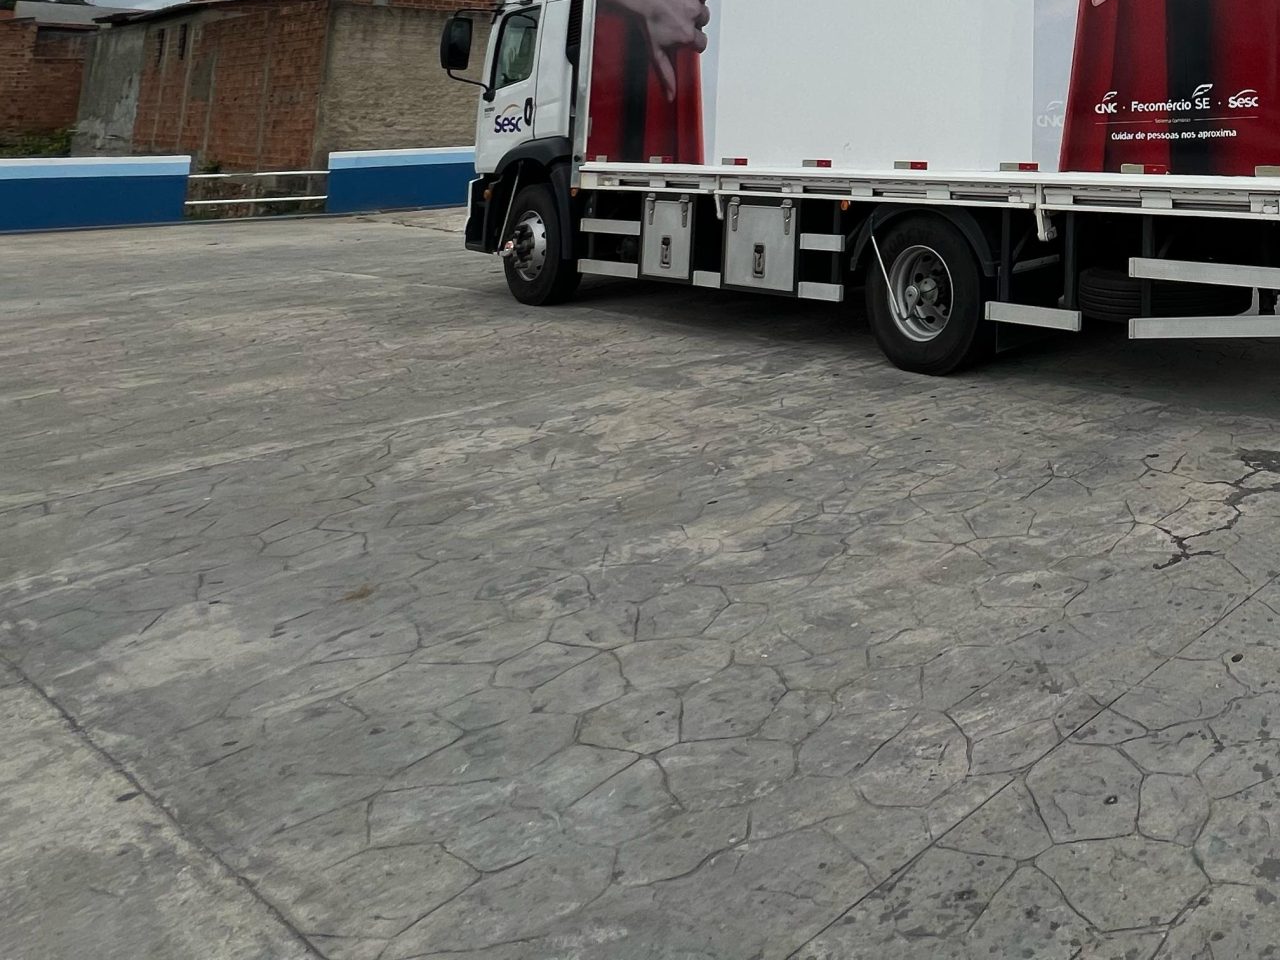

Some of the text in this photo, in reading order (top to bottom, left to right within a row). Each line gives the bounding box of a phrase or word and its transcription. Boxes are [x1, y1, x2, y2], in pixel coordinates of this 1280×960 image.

[1094, 96, 1259, 114] CNC Fecomércio SE Sesc
[494, 114, 522, 134] Sesc
[1111, 128, 1237, 140] Cuidar de pessoas nos aproxima
